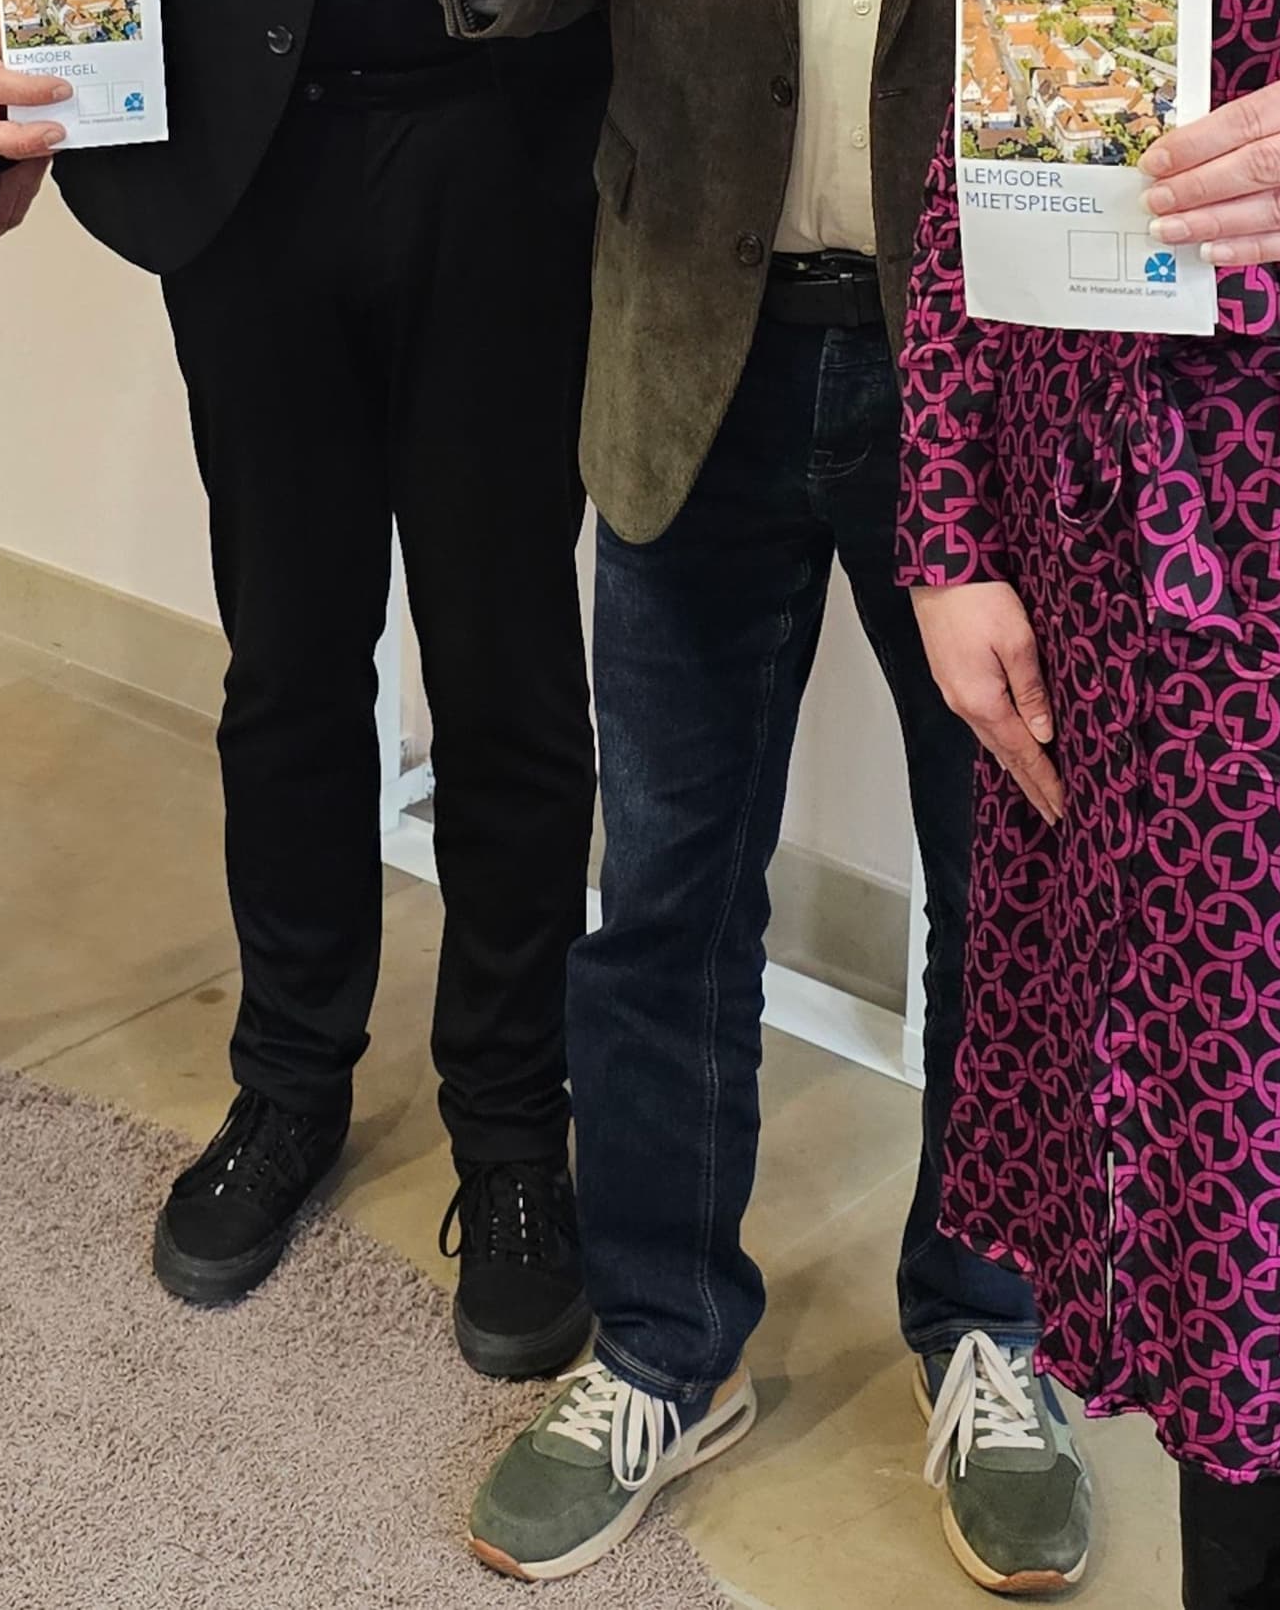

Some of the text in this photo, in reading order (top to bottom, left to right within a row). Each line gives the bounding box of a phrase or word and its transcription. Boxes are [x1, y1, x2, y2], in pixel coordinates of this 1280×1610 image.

[9, 50, 73, 66] LEMGOER
[963, 168, 1063, 188] LEMGOER
[965, 192, 1104, 214] MIETSPIEGEL
